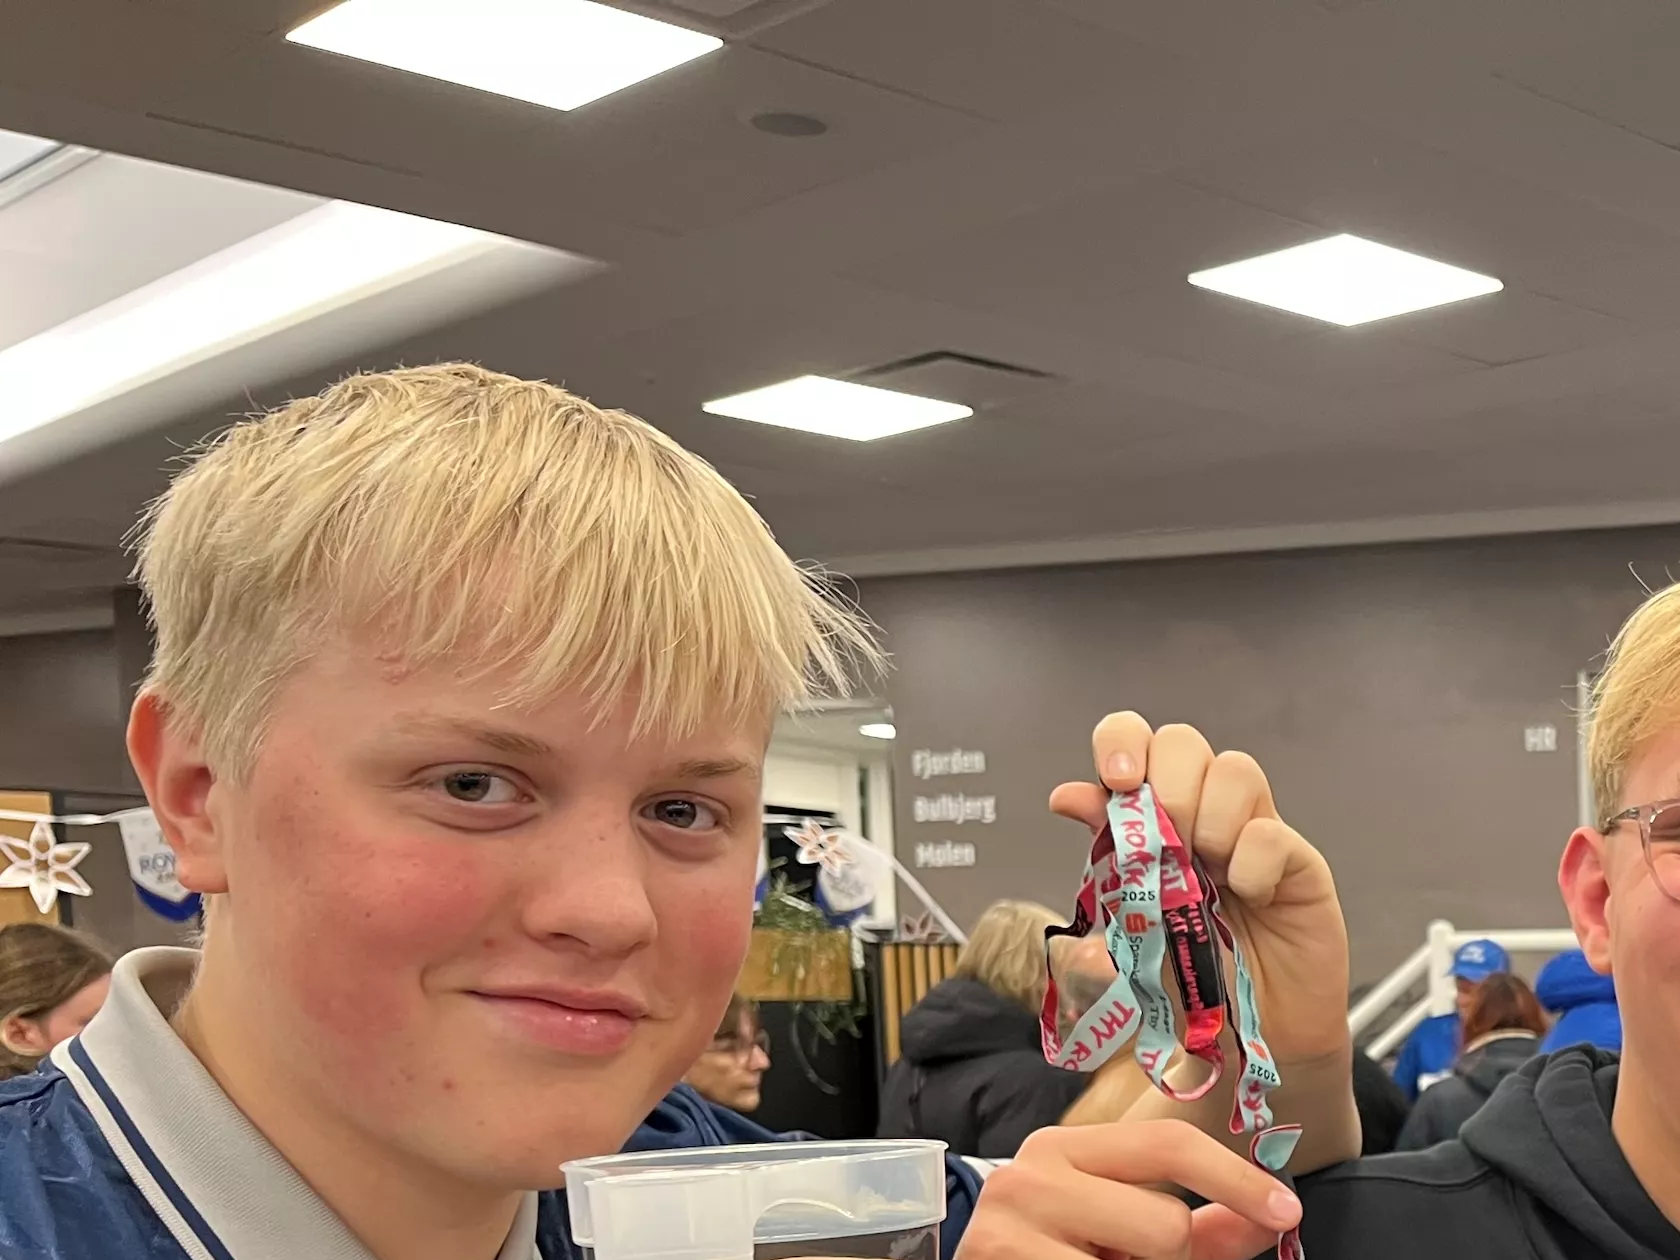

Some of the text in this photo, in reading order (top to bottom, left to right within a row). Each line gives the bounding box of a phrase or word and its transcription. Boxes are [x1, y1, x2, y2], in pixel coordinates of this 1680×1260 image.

[1524, 726, 1557, 752] HR
[912, 748, 986, 780] Fjorden
[914, 793, 997, 825] Bulbjerg
[914, 840, 976, 869] Molen
[1121, 890, 1157, 902] 2025
[1089, 1000, 1135, 1049] THY
